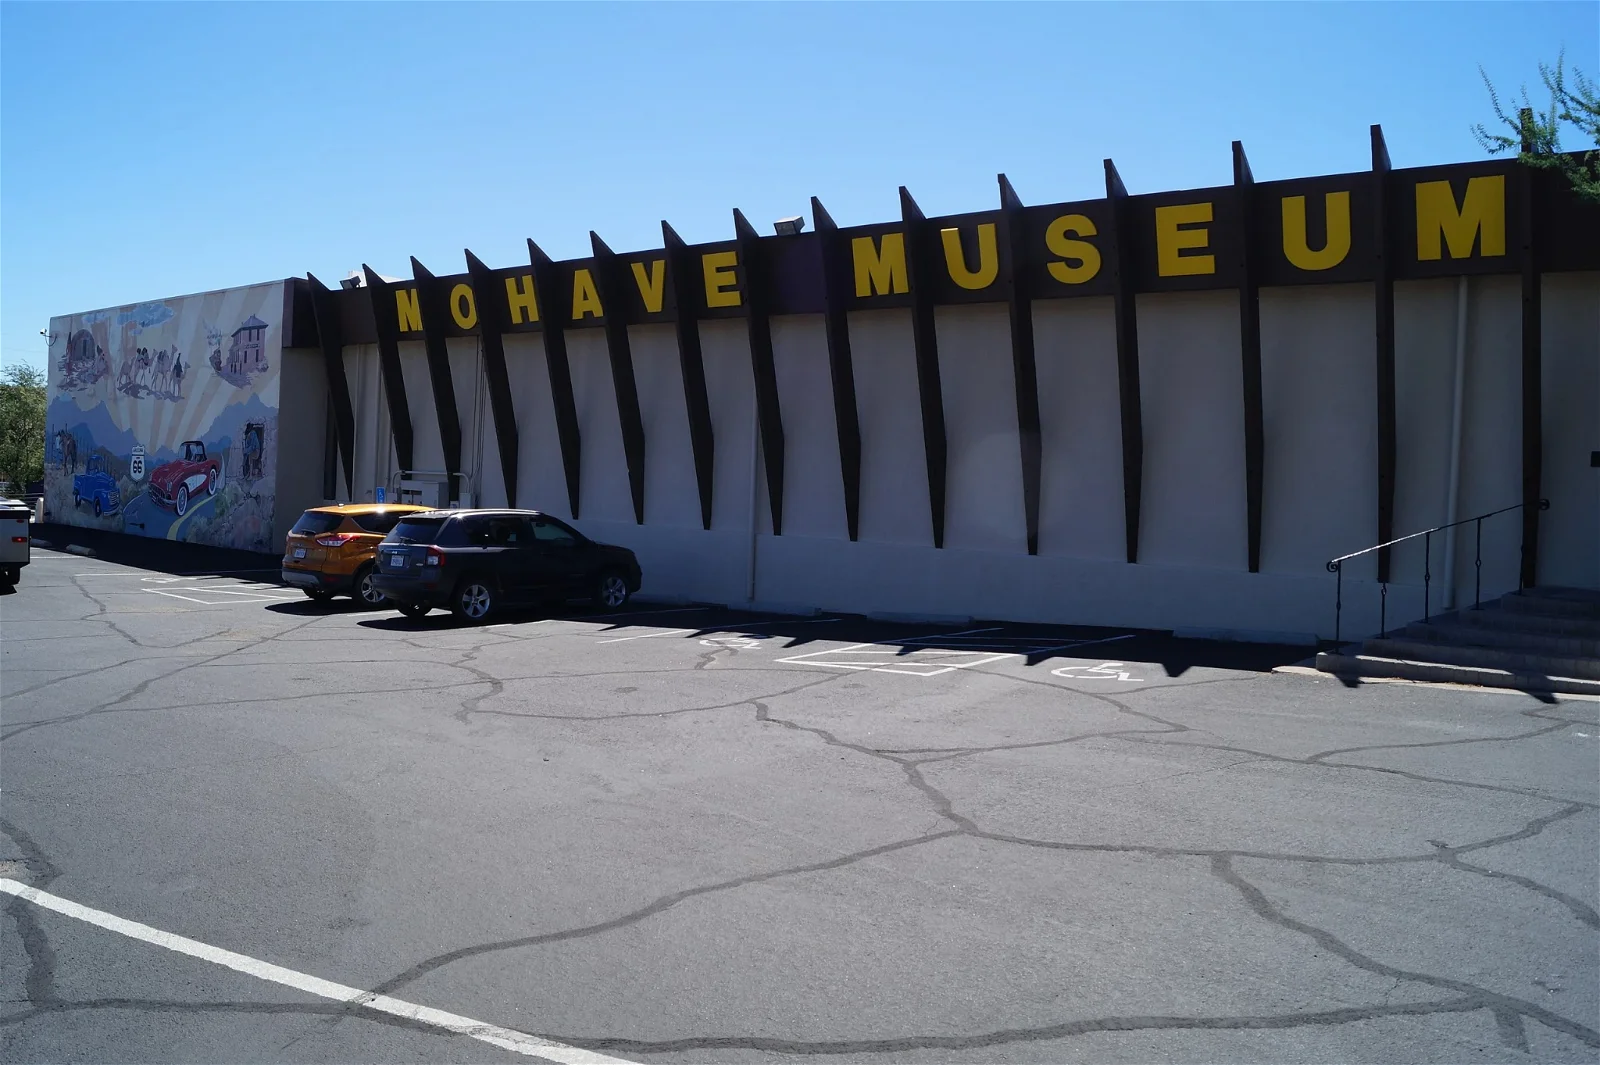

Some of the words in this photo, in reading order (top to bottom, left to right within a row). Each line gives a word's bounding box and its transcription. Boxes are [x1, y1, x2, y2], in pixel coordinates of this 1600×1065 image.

[395, 251, 741, 333] MOHAVE
[851, 174, 1506, 298] MUSEUM
[133, 460, 142, 474] 66
